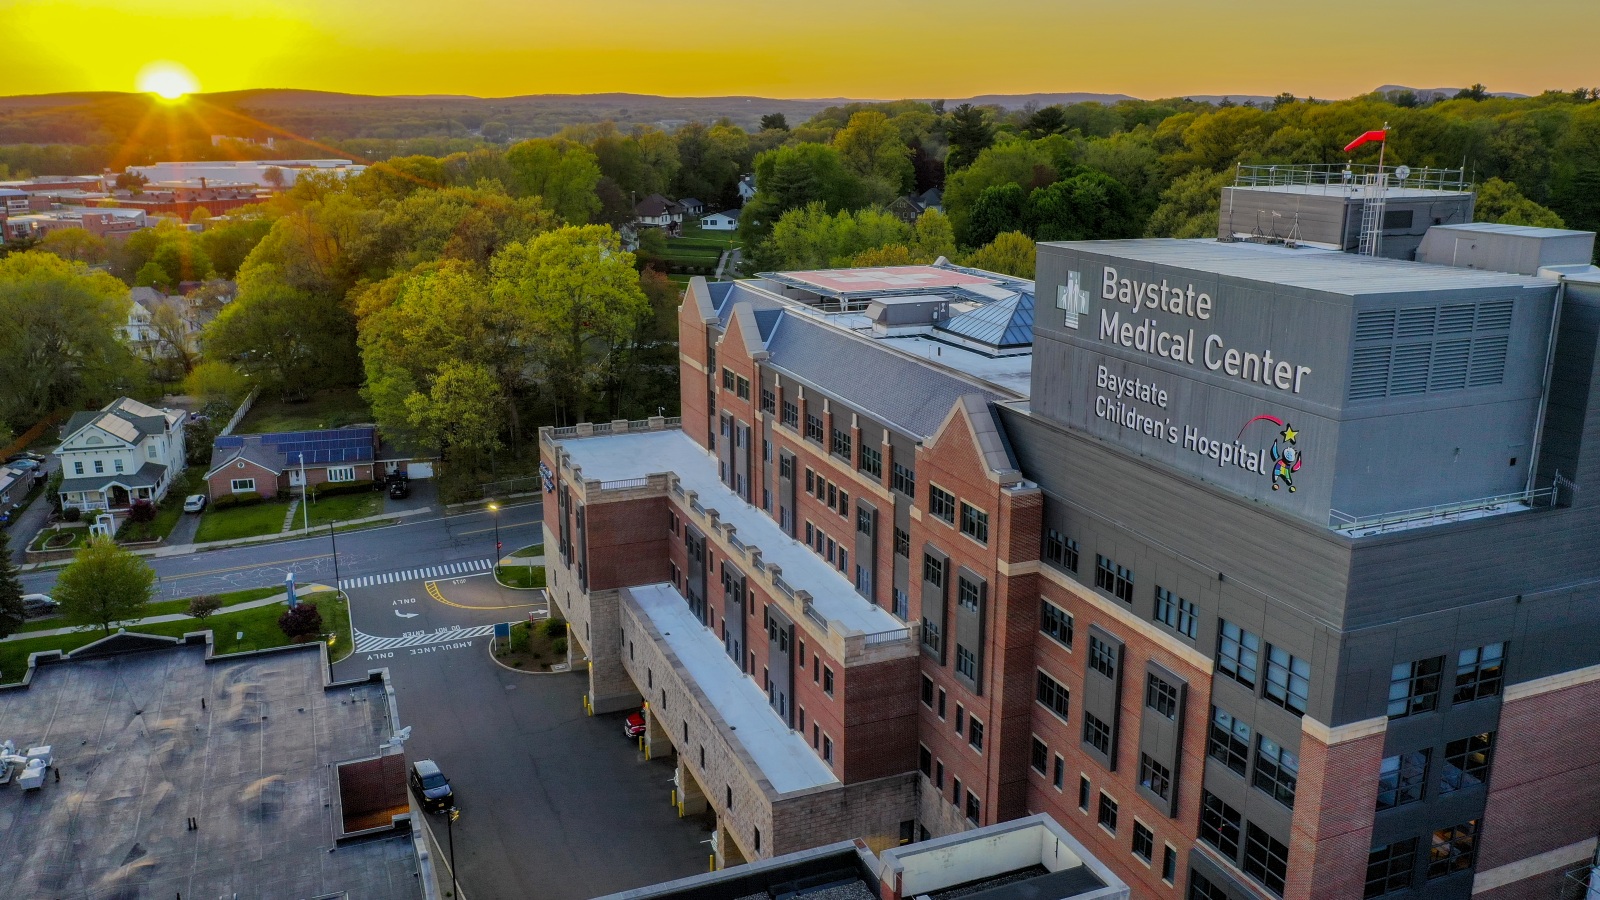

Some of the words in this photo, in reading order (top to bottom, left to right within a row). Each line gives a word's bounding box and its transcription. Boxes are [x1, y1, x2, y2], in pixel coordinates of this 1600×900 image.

[1101, 266, 1212, 320] Baystate
[1100, 308, 1195, 365] Medical
[1203, 334, 1312, 393] Center
[1096, 365, 1168, 408] Baystate
[1095, 395, 1178, 444] Children's
[1183, 425, 1266, 475] Hospital
[392, 598, 416, 606] ONLY
[402, 630, 425, 638] ENTER
[409, 641, 473, 655] AMBULANCE
[367, 652, 394, 661] ONLY
